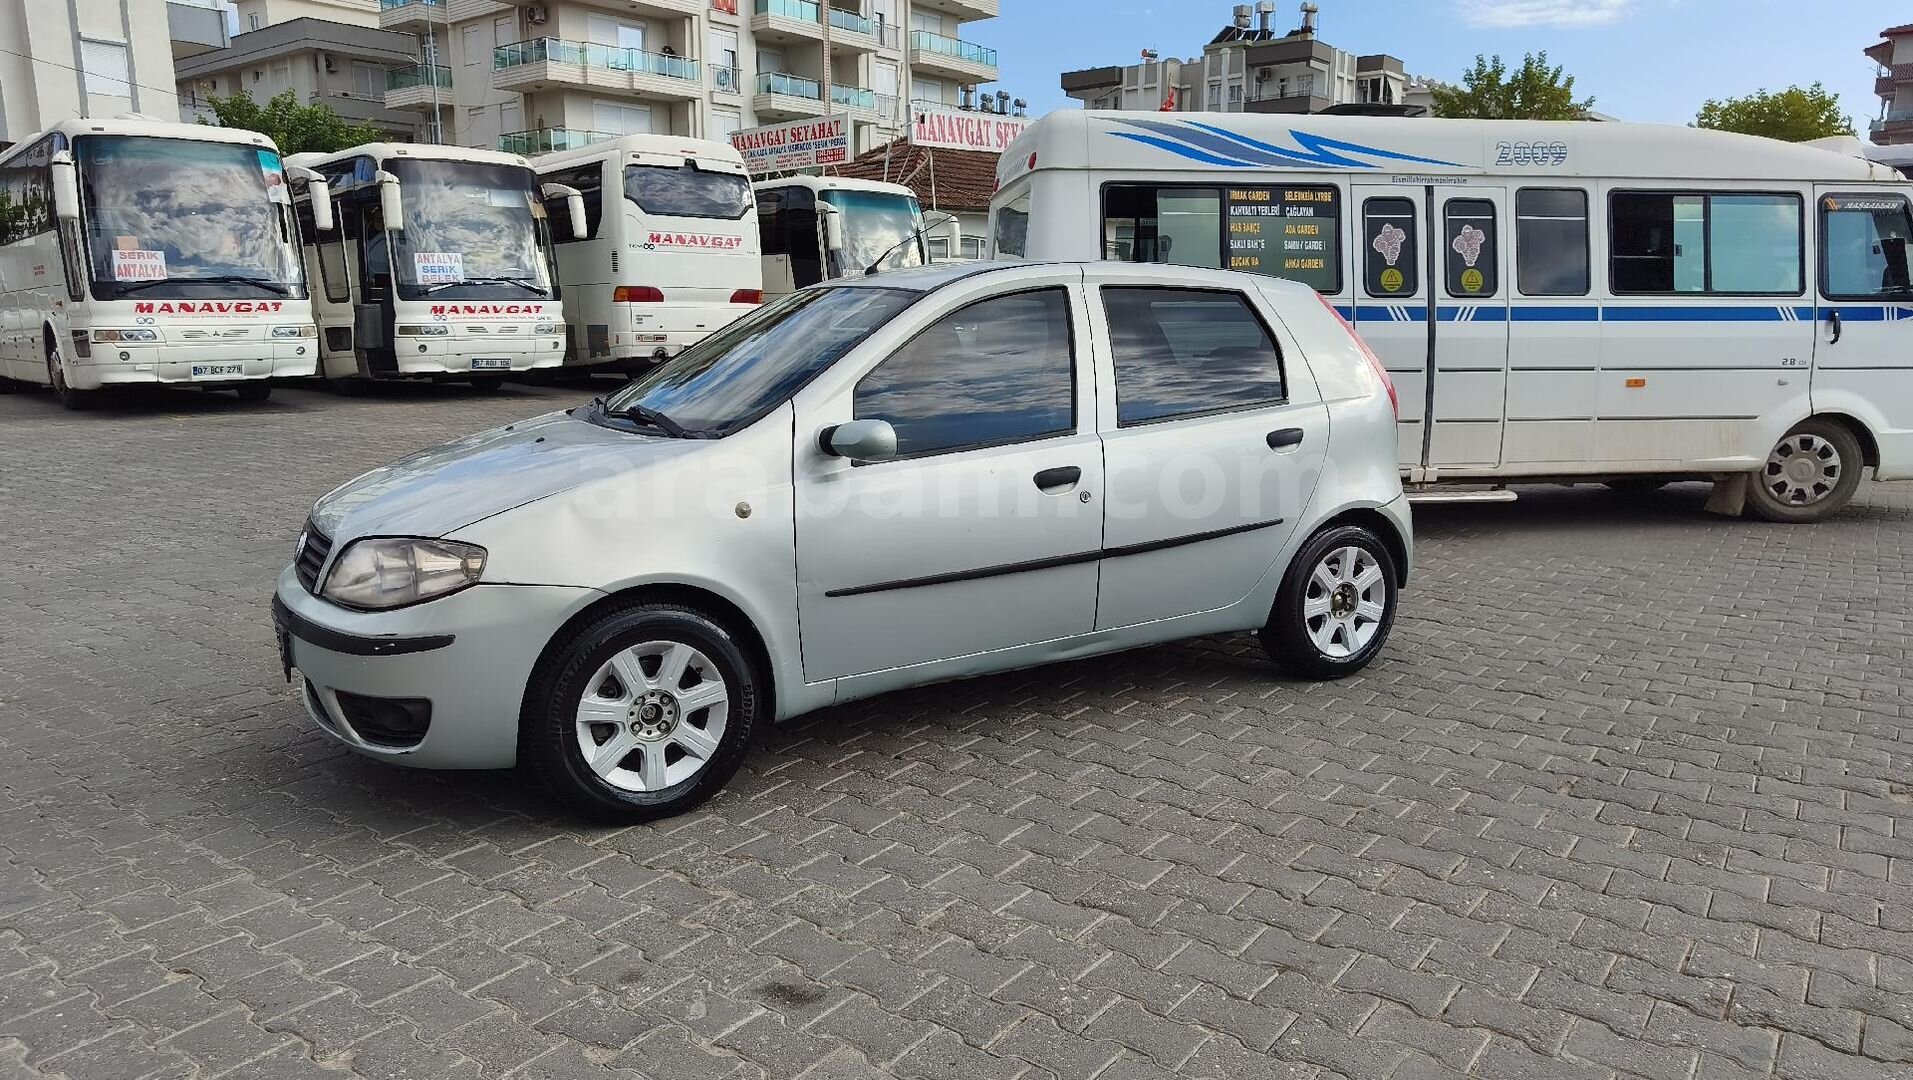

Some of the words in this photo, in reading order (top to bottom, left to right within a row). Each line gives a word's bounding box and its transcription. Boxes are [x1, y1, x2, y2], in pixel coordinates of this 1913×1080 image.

[790, 119, 841, 143] SEYAHAT
[914, 110, 991, 145] MANAVGAT
[1496, 140, 1567, 166] 2009
[1248, 190, 1270, 200] GARDEN
[1285, 204, 1314, 218] ÇAĞLAYAN
[1297, 224, 1319, 235] GARDEN
[648, 232, 742, 247] MANAVGAT
[417, 253, 461, 264] ANTALYA
[1301, 258, 1324, 269] GARDEN
[116, 263, 166, 278] ANTALYA
[422, 274, 459, 283] BELEK
[135, 302, 283, 313] MANAVGAT
[430, 305, 542, 315] MANAVGAT
[197, 367, 208, 375] 07
